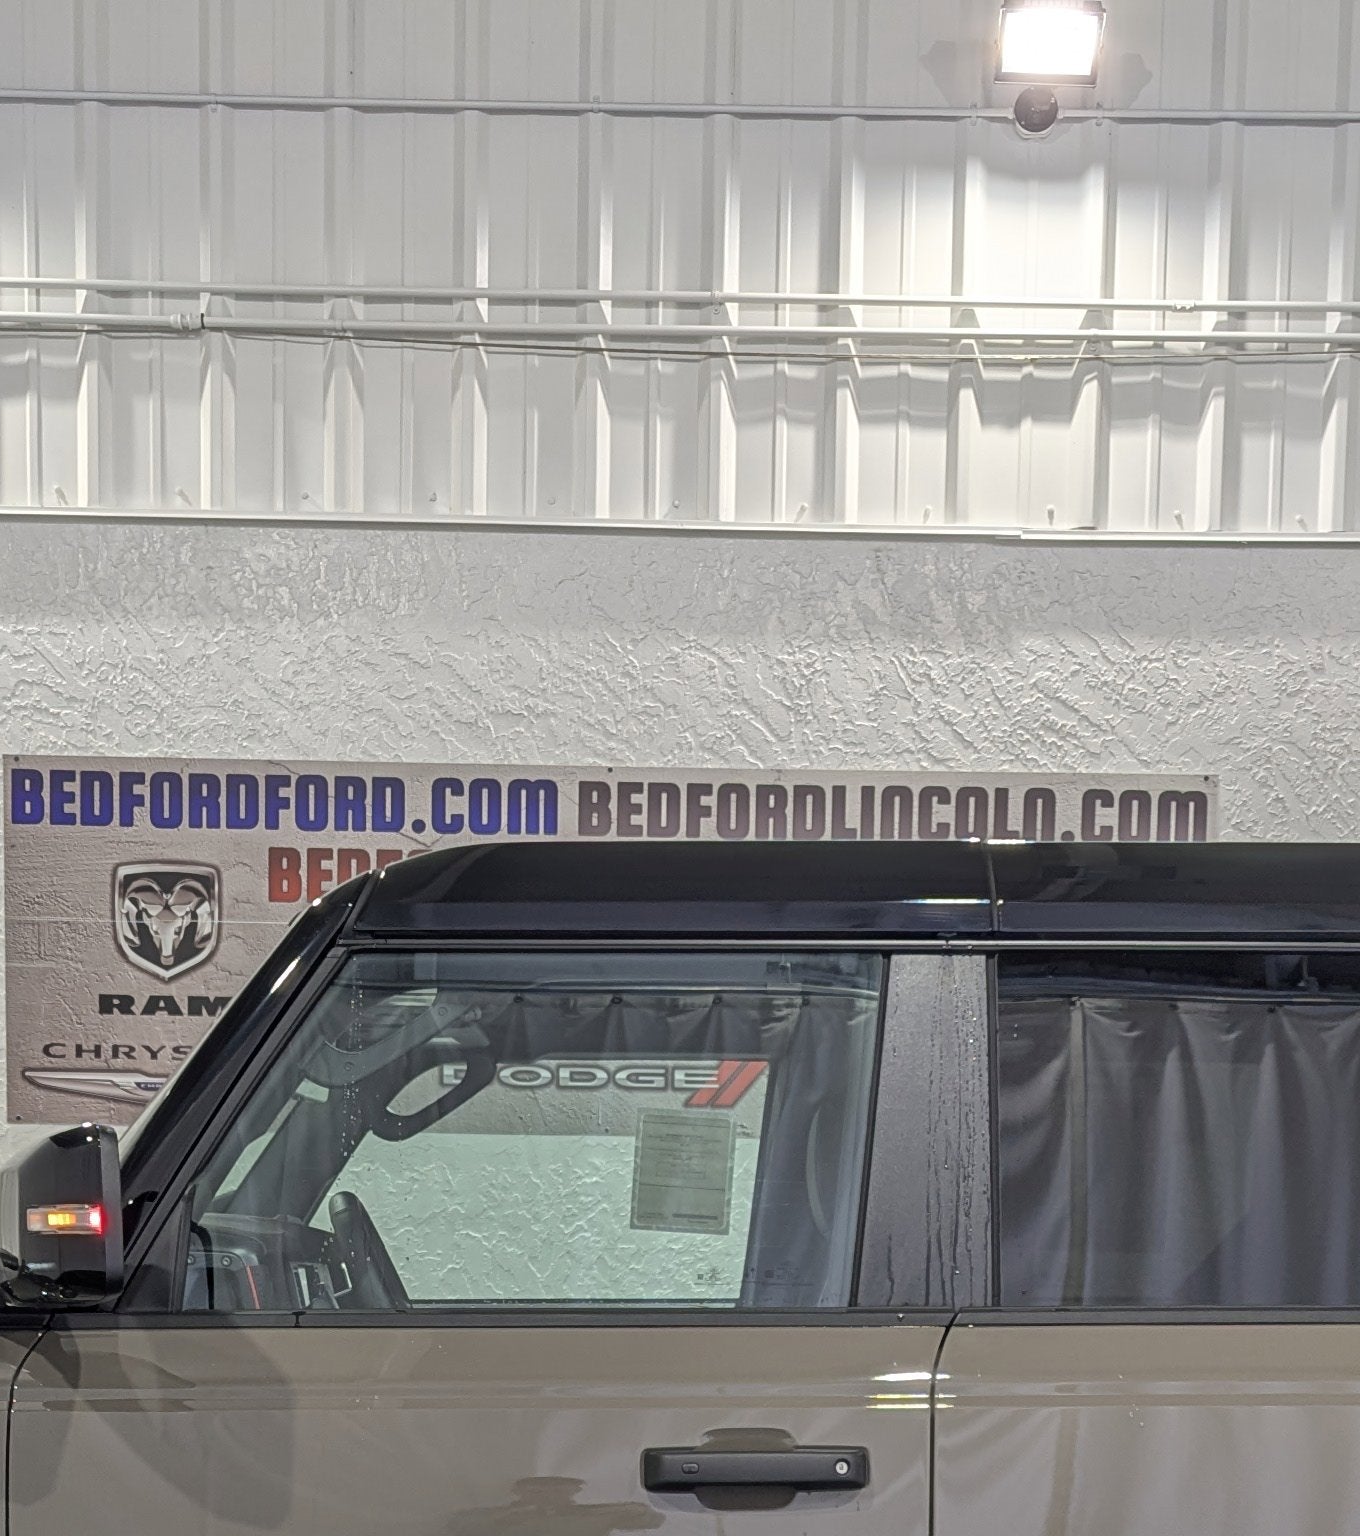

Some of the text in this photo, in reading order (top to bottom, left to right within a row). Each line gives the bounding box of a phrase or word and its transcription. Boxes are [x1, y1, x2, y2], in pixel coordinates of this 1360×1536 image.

[10, 767, 1208, 843] BEDFORDFORD.COM BEDFORDLINCOLN.COM
[98, 993, 232, 1017] RAM
